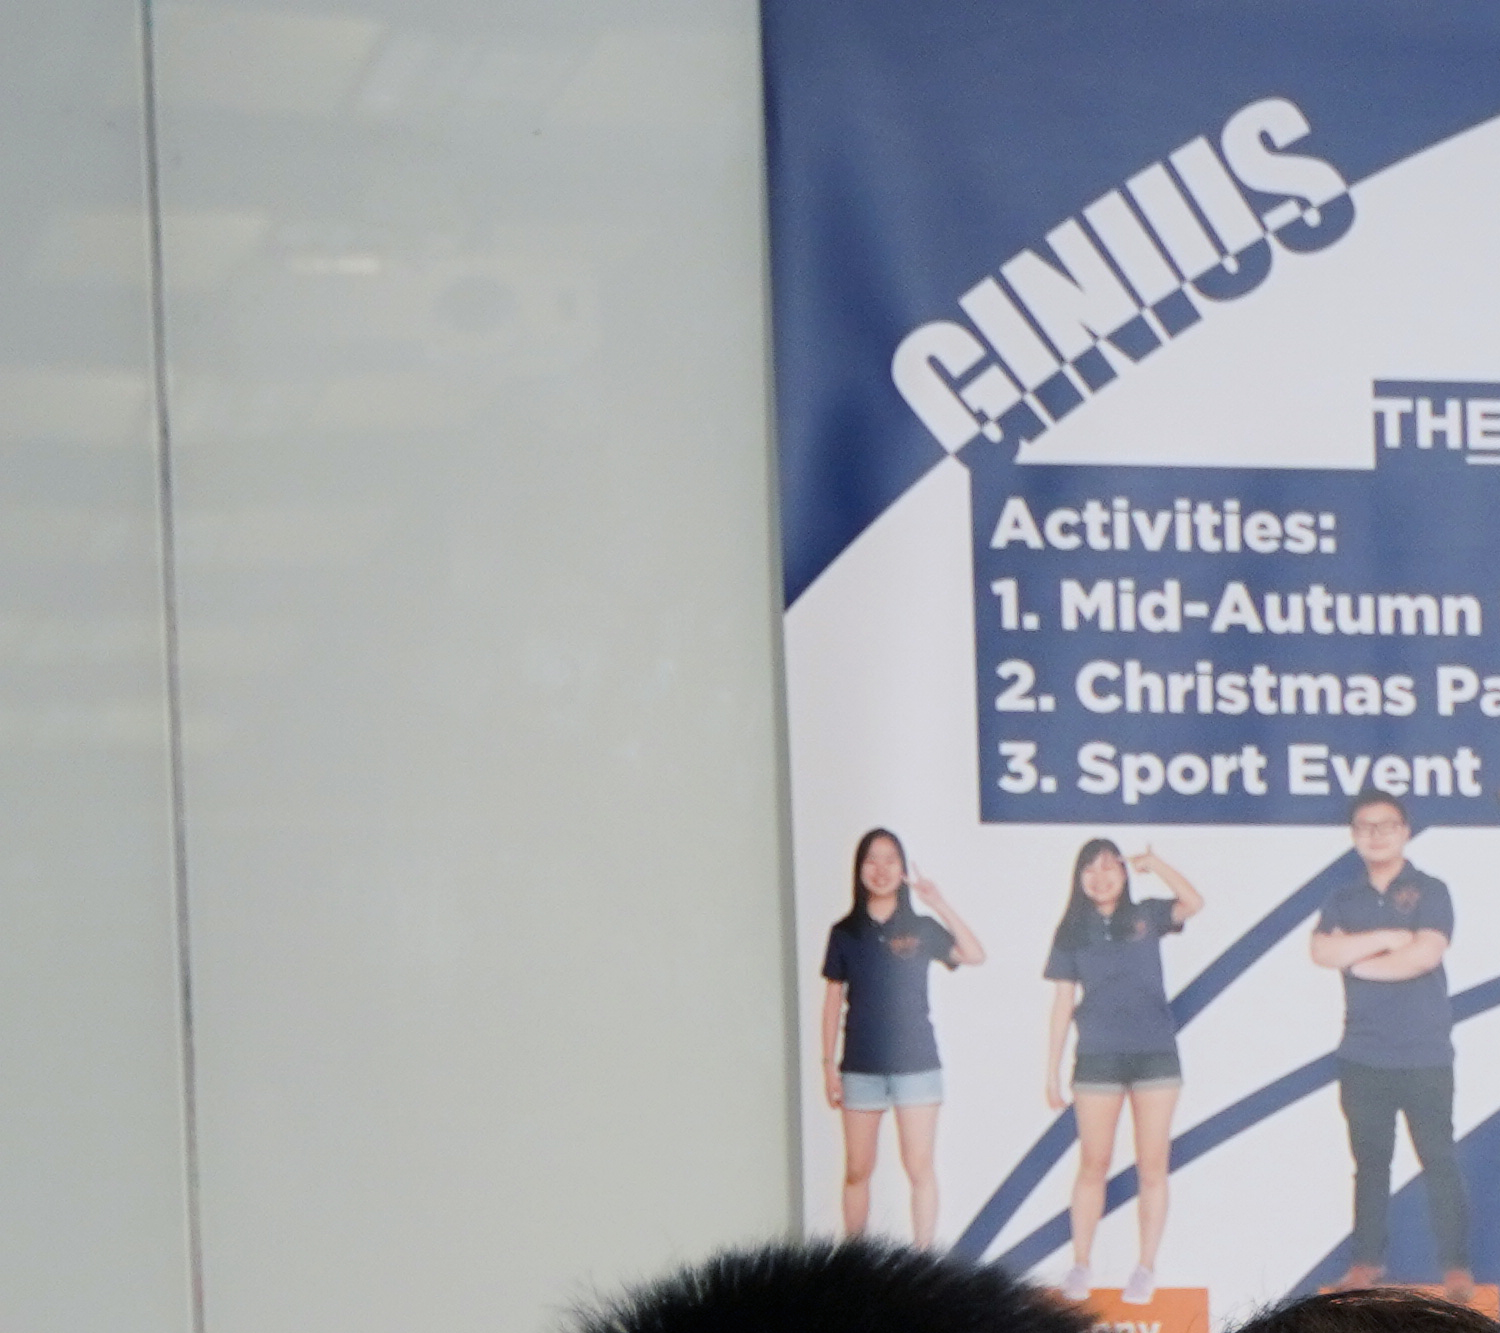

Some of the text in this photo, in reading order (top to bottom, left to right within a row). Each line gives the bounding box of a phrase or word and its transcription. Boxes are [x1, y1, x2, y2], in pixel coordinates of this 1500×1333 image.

[990, 496, 1338, 554] Activities:
[991, 577, 1041, 632] 1.
[1060, 578, 1483, 638] Mid-Autumn
[994, 659, 1056, 714] 2.
[1074, 659, 1417, 717] Christmas
[997, 740, 1483, 806] 3. Sport Event
